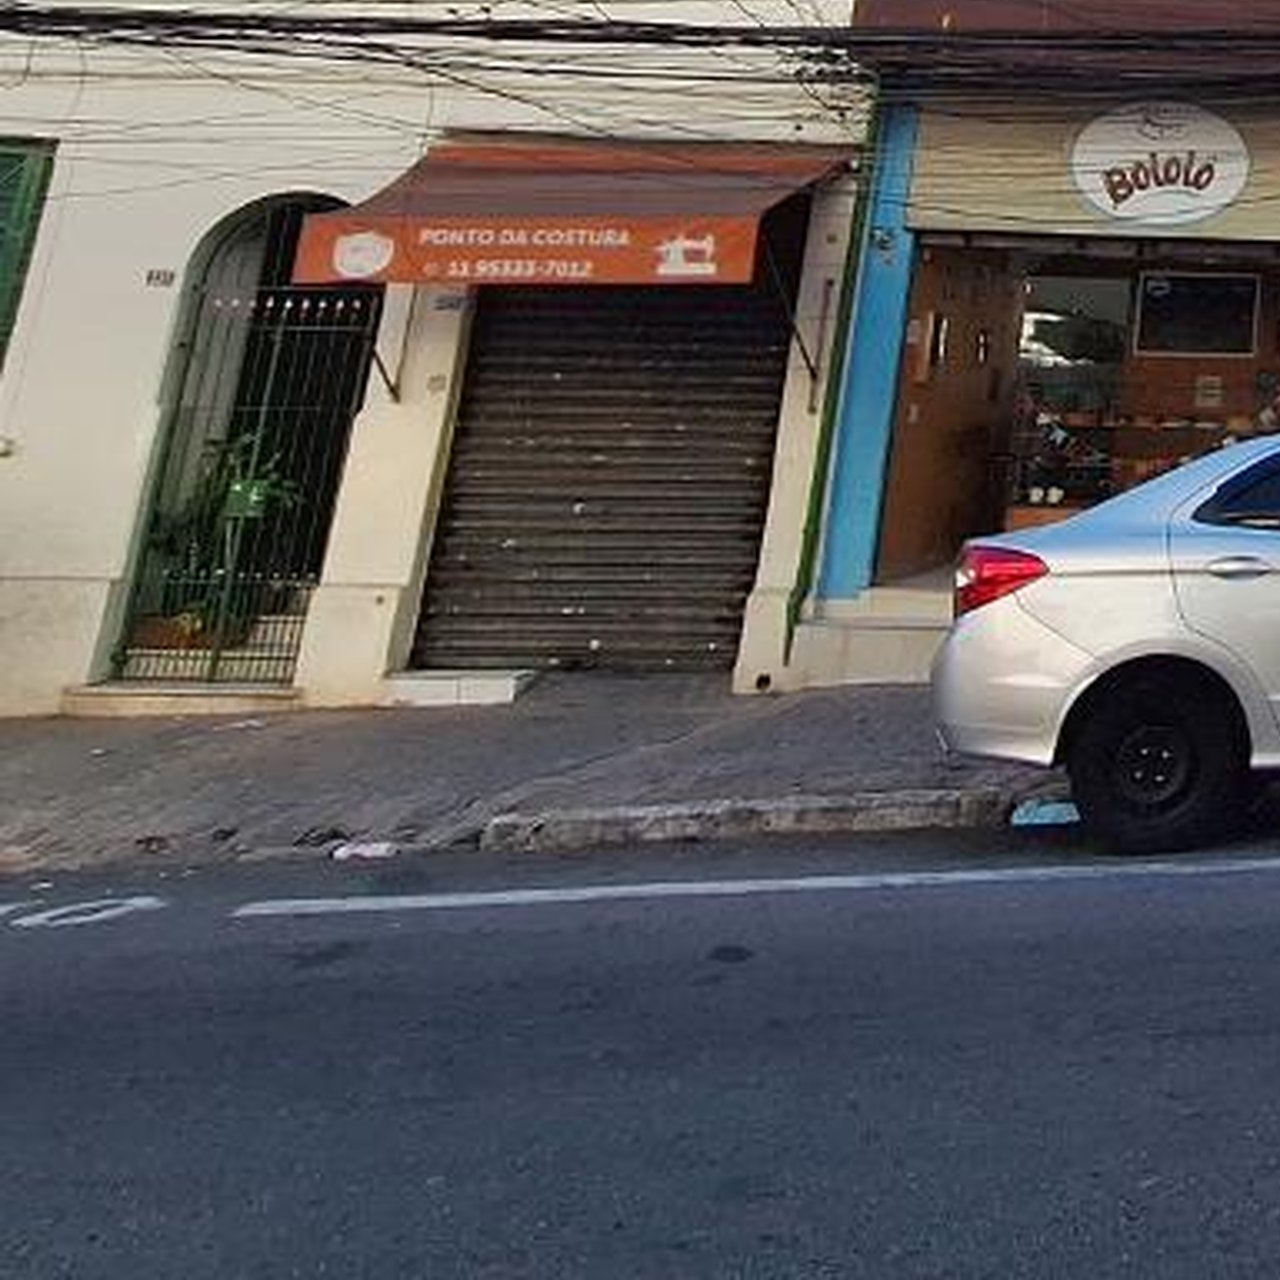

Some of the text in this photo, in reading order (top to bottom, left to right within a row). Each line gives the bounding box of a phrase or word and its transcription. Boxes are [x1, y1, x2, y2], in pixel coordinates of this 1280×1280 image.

[420, 228, 631, 247] PONTO DA COSTURA
[449, 260, 469, 277] 11
